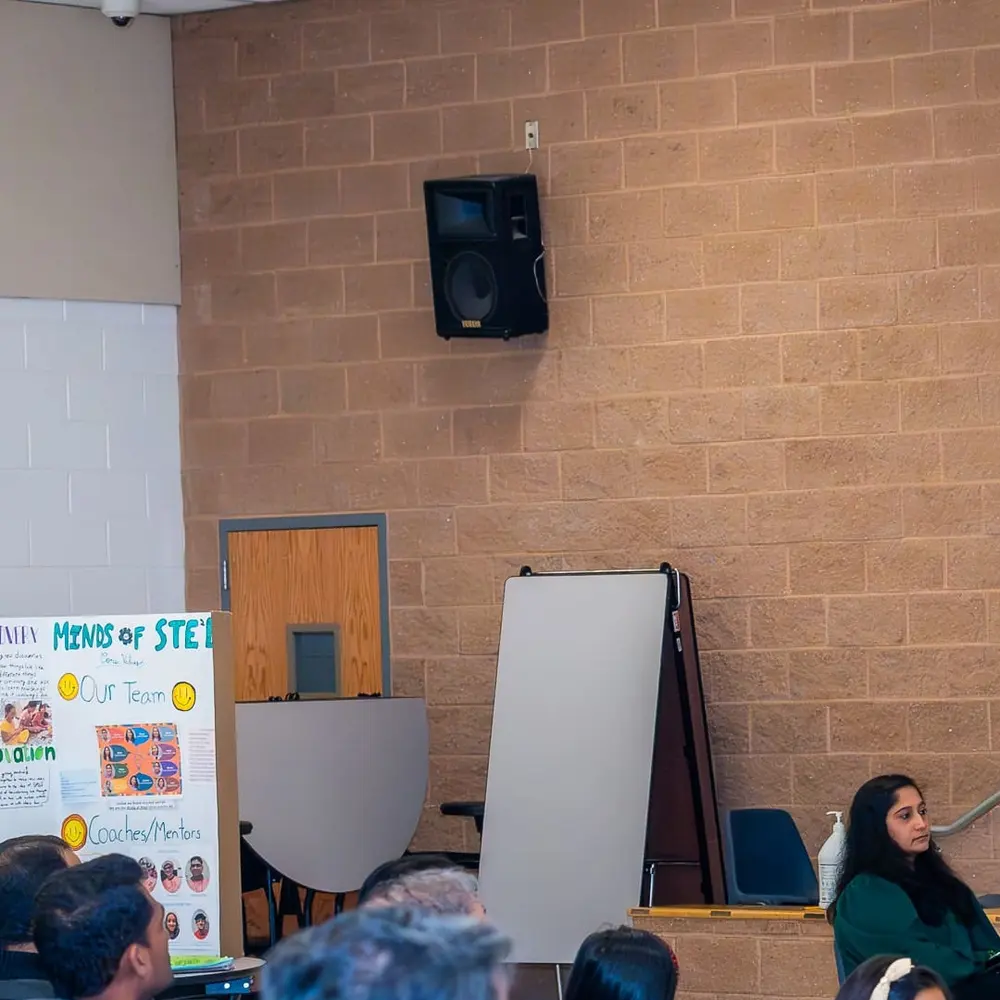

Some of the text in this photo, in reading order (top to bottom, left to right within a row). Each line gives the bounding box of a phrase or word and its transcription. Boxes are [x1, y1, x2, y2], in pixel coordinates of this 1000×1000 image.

[53, 621, 114, 651] MINDS
[80, 675, 165, 705] Our Team
[88, 814, 201, 845] Coaches/Mentors
